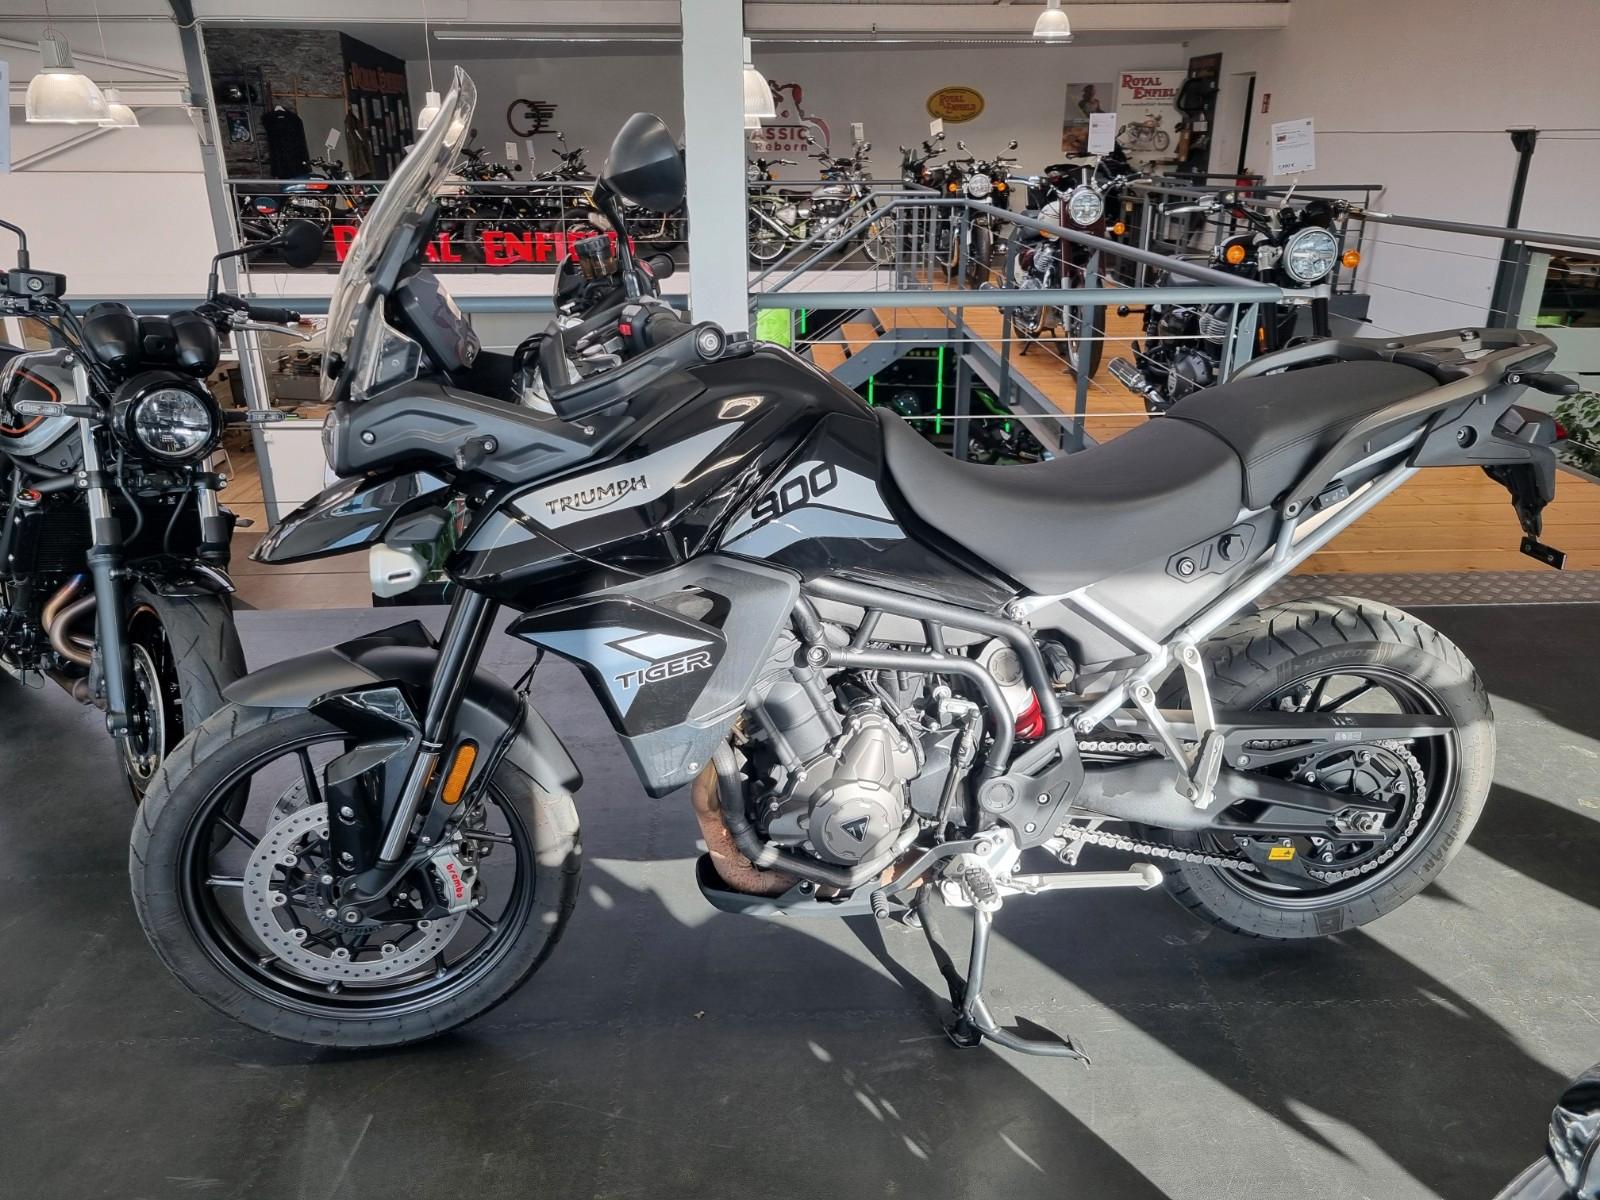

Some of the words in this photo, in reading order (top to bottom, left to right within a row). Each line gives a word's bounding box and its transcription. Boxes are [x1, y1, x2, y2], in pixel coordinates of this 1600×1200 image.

[1121, 74, 1162, 89] ROYAL
[1133, 87, 1180, 99] ENFIEL
[750, 127, 808, 141] ASSIC
[754, 141, 808, 153] Reborn
[332, 225, 463, 263] RAL
[545, 475, 648, 516] TRIUMPH
[751, 463, 838, 521] 900
[614, 650, 712, 691] TIGER
[446, 863, 465, 898] brembo
